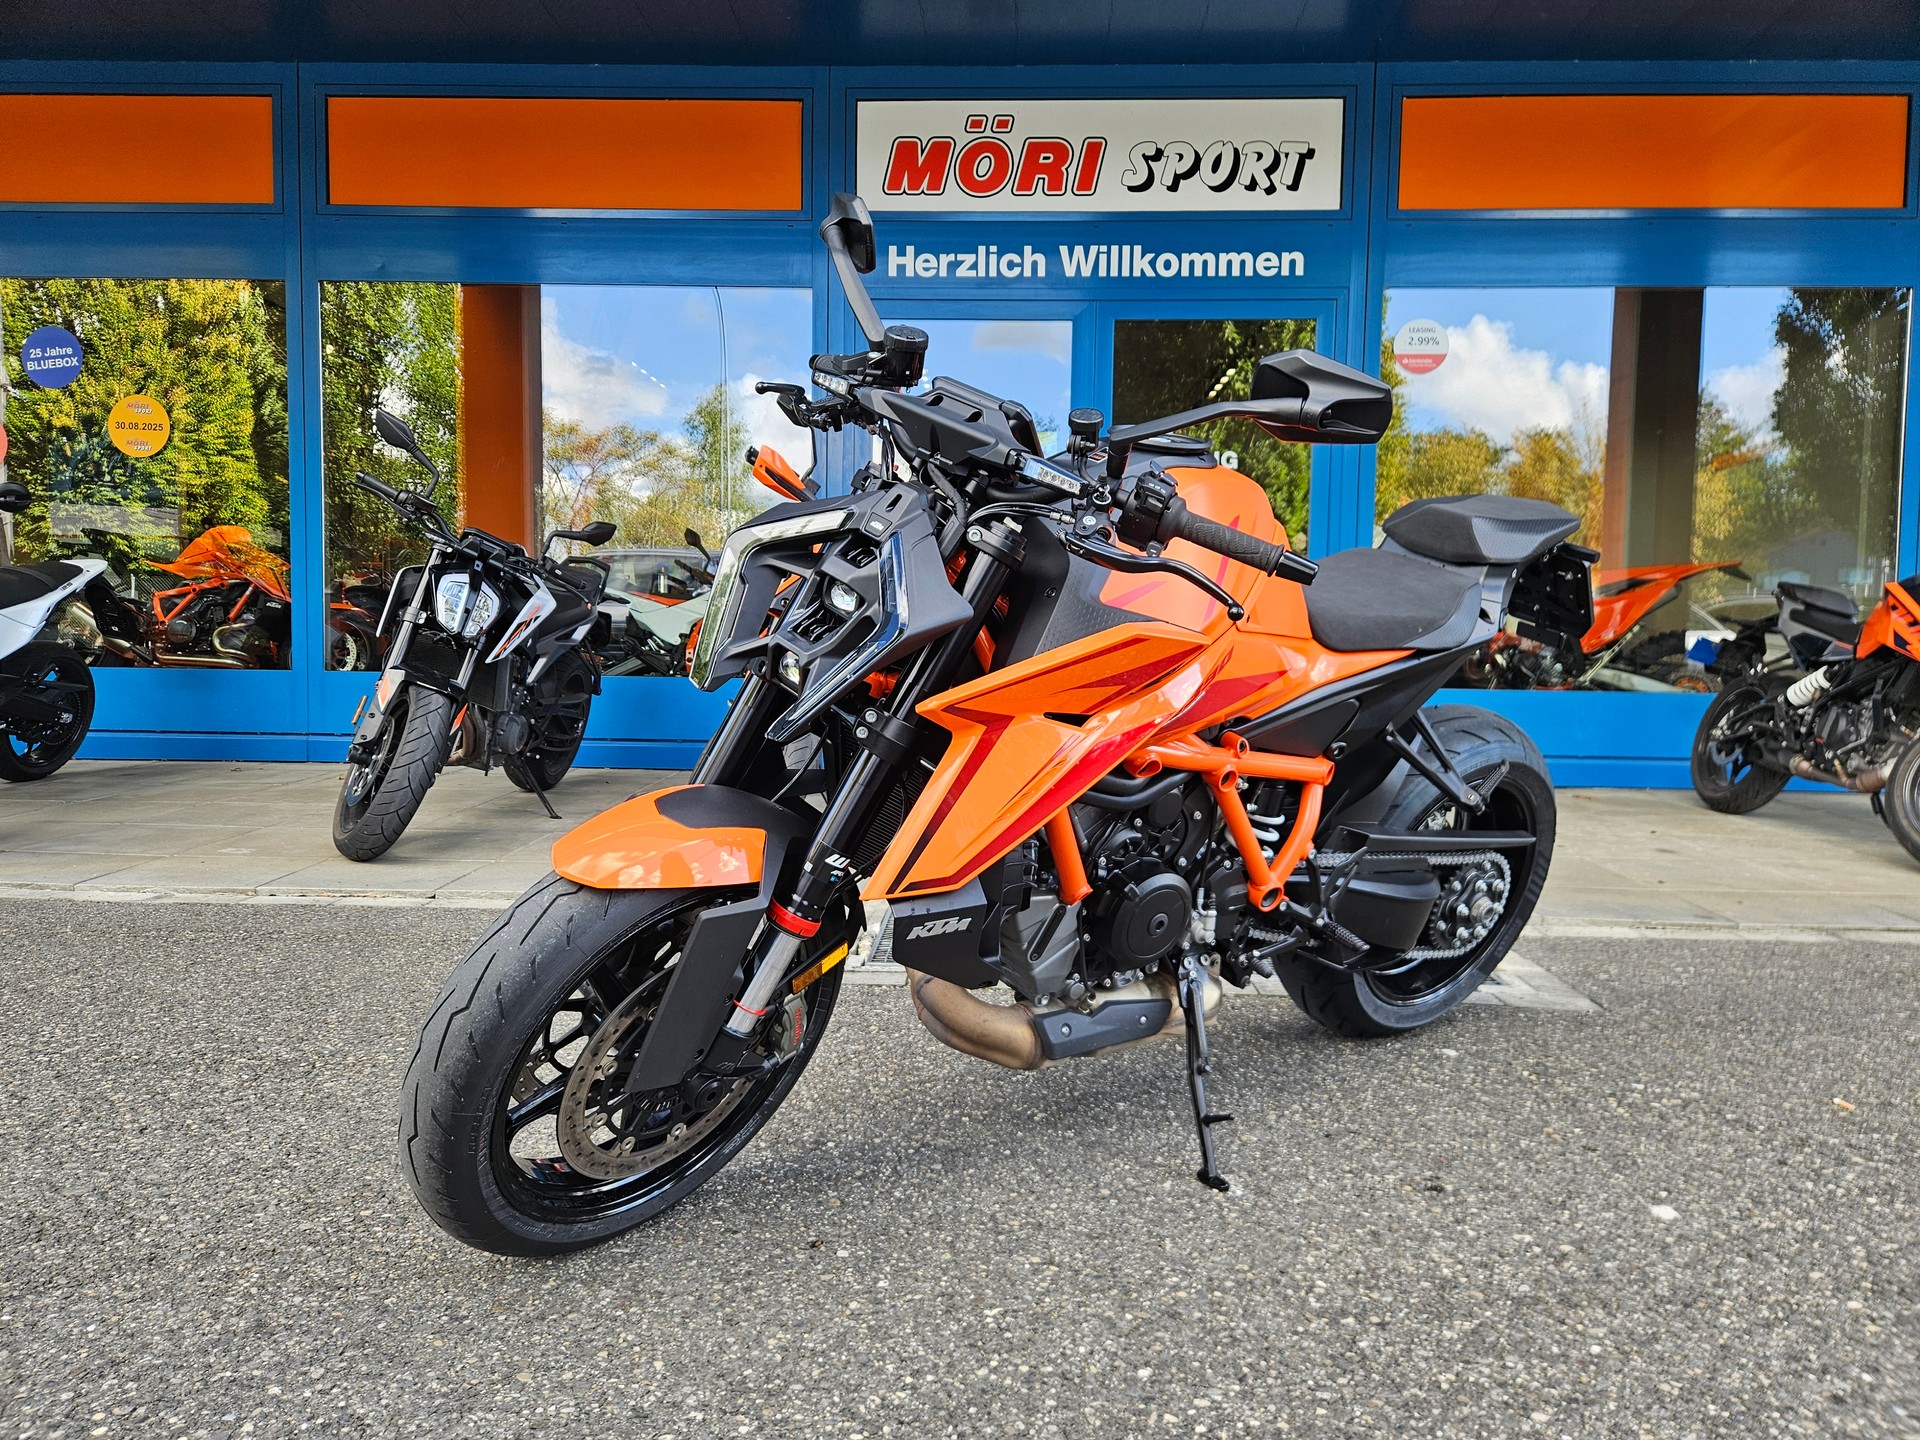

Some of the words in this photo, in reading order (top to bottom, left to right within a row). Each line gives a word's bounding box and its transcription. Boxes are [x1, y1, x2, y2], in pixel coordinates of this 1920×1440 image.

[882, 114, 1107, 198] MÖRI
[1121, 140, 1315, 196] SPORT
[888, 245, 1046, 278] Herzlich
[1059, 245, 1305, 277] Willkommen
[1408, 336, 1440, 346] 2.99%
[29, 348, 42, 359] 25
[44, 346, 73, 357] Jahre
[26, 356, 79, 371] BLUEBOX
[115, 421, 164, 431] 30.08.2025
[905, 916, 972, 941] KTM
